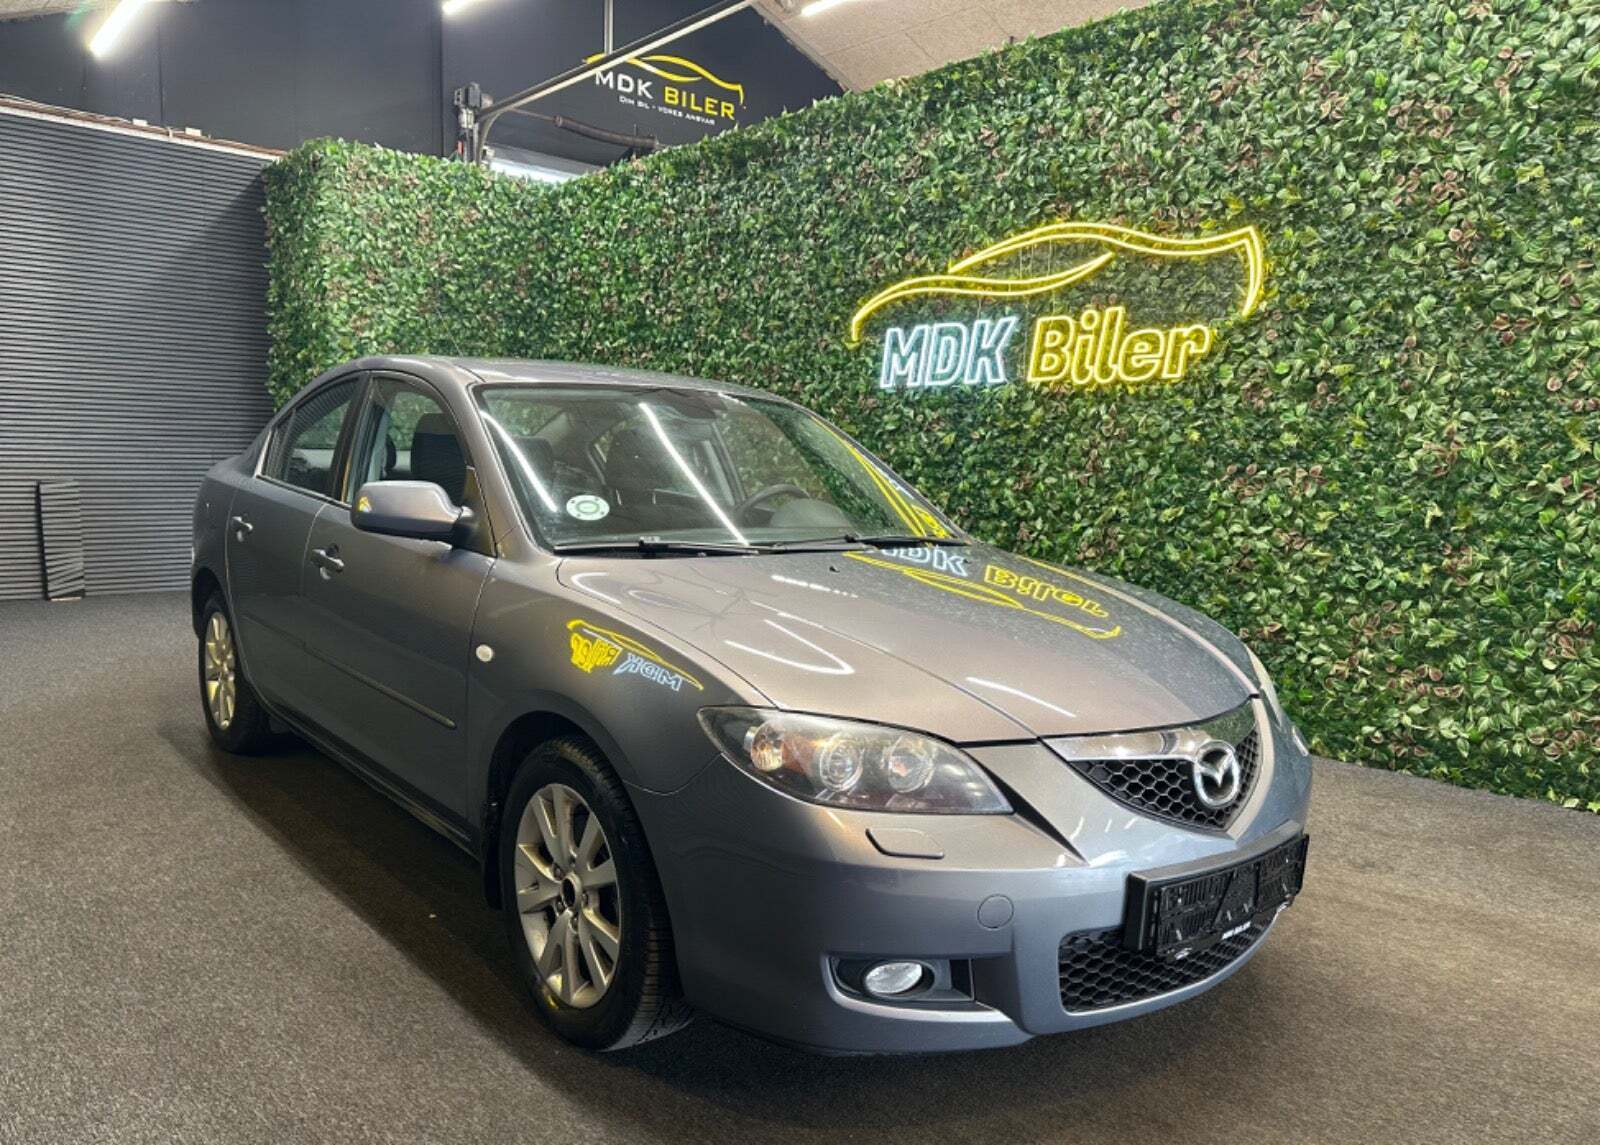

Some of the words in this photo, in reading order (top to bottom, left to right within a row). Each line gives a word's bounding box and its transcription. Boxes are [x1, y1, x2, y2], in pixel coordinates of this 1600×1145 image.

[595, 70, 653, 99] MDK
[664, 86, 735, 120] BILER
[880, 315, 1018, 388] MDK
[1027, 306, 1210, 385] Biler
